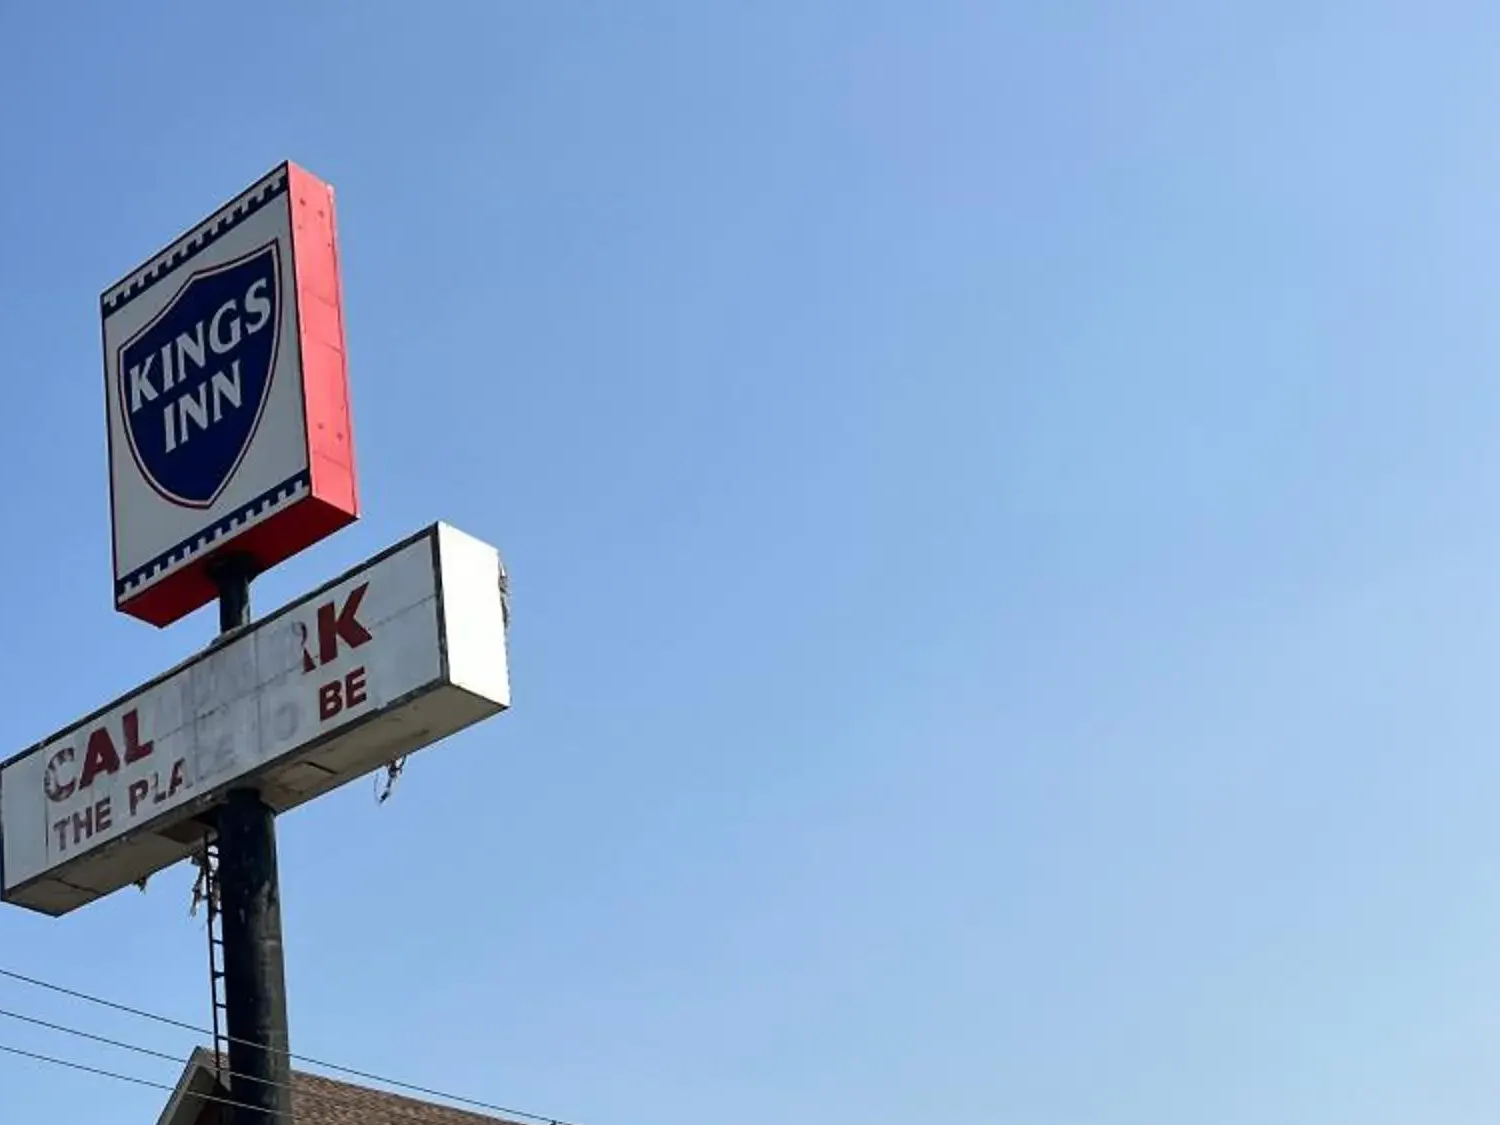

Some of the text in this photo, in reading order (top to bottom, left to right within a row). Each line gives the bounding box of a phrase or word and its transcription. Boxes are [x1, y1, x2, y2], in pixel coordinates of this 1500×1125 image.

[130, 277, 272, 413] KINGS
[164, 359, 243, 454] INN
[53, 798, 112, 851] THE
[319, 666, 367, 722] BE
